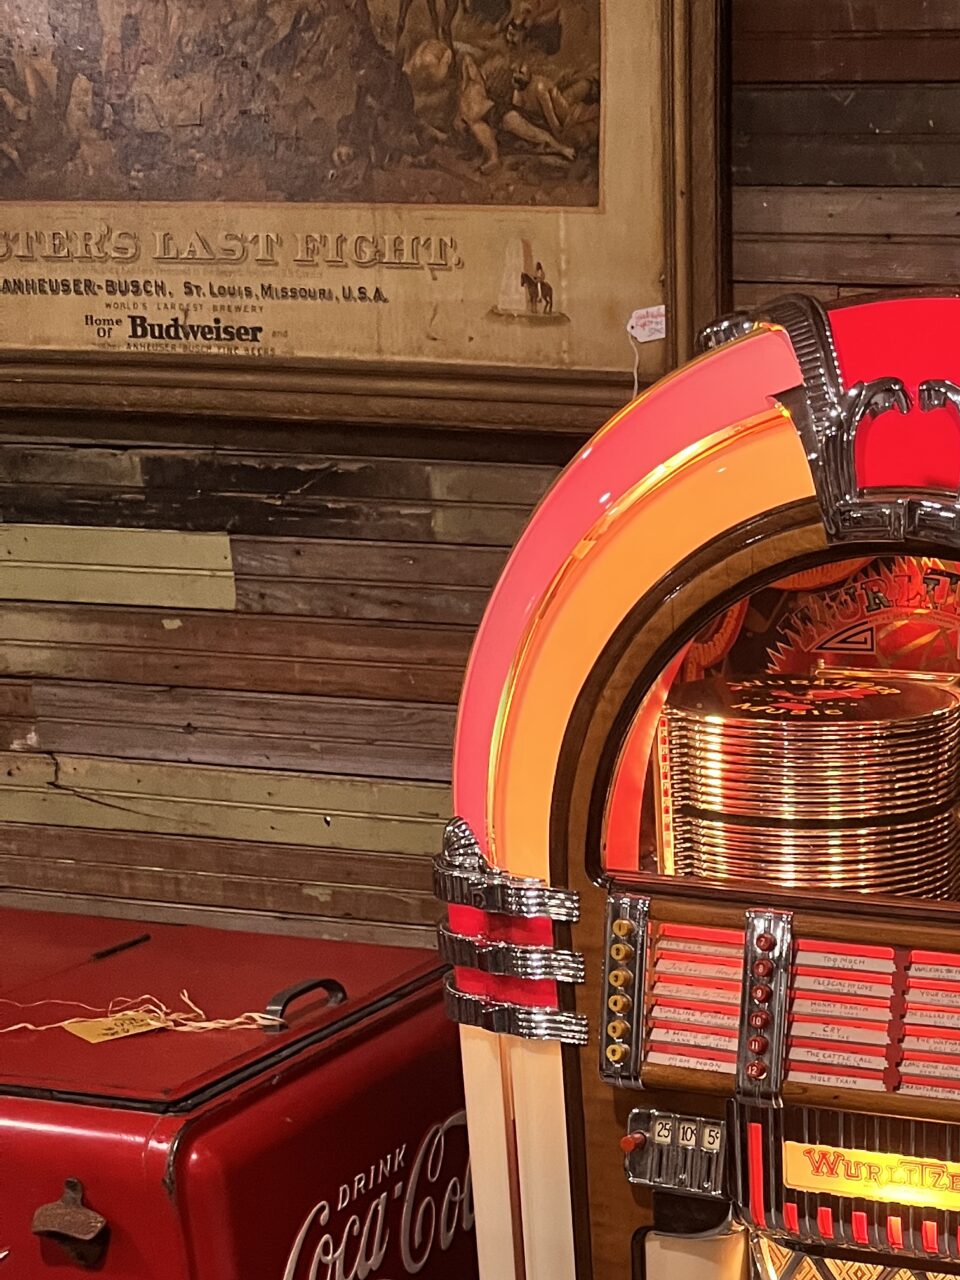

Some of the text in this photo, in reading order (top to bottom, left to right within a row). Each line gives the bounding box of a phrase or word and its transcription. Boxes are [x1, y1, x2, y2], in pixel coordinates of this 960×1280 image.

[152, 231, 283, 267] LAST
[293, 232, 464, 271] FIGHT.
[157, 302, 204, 312] LARGEST
[212, 304, 264, 313] BREWERY
[84, 314, 123, 326] Home
[97, 327, 113, 338] Of
[127, 315, 263, 342] Budweiser
[822, 1026, 842, 1034] CRY
[806, 1050, 819, 1058] THE
[822, 1053, 852, 1061] CATTLE
[809, 1075, 857, 1085] MULE TRAIN
[707, 1129, 720, 1145] 5¢
[337, 1143, 407, 1212] DRINK
